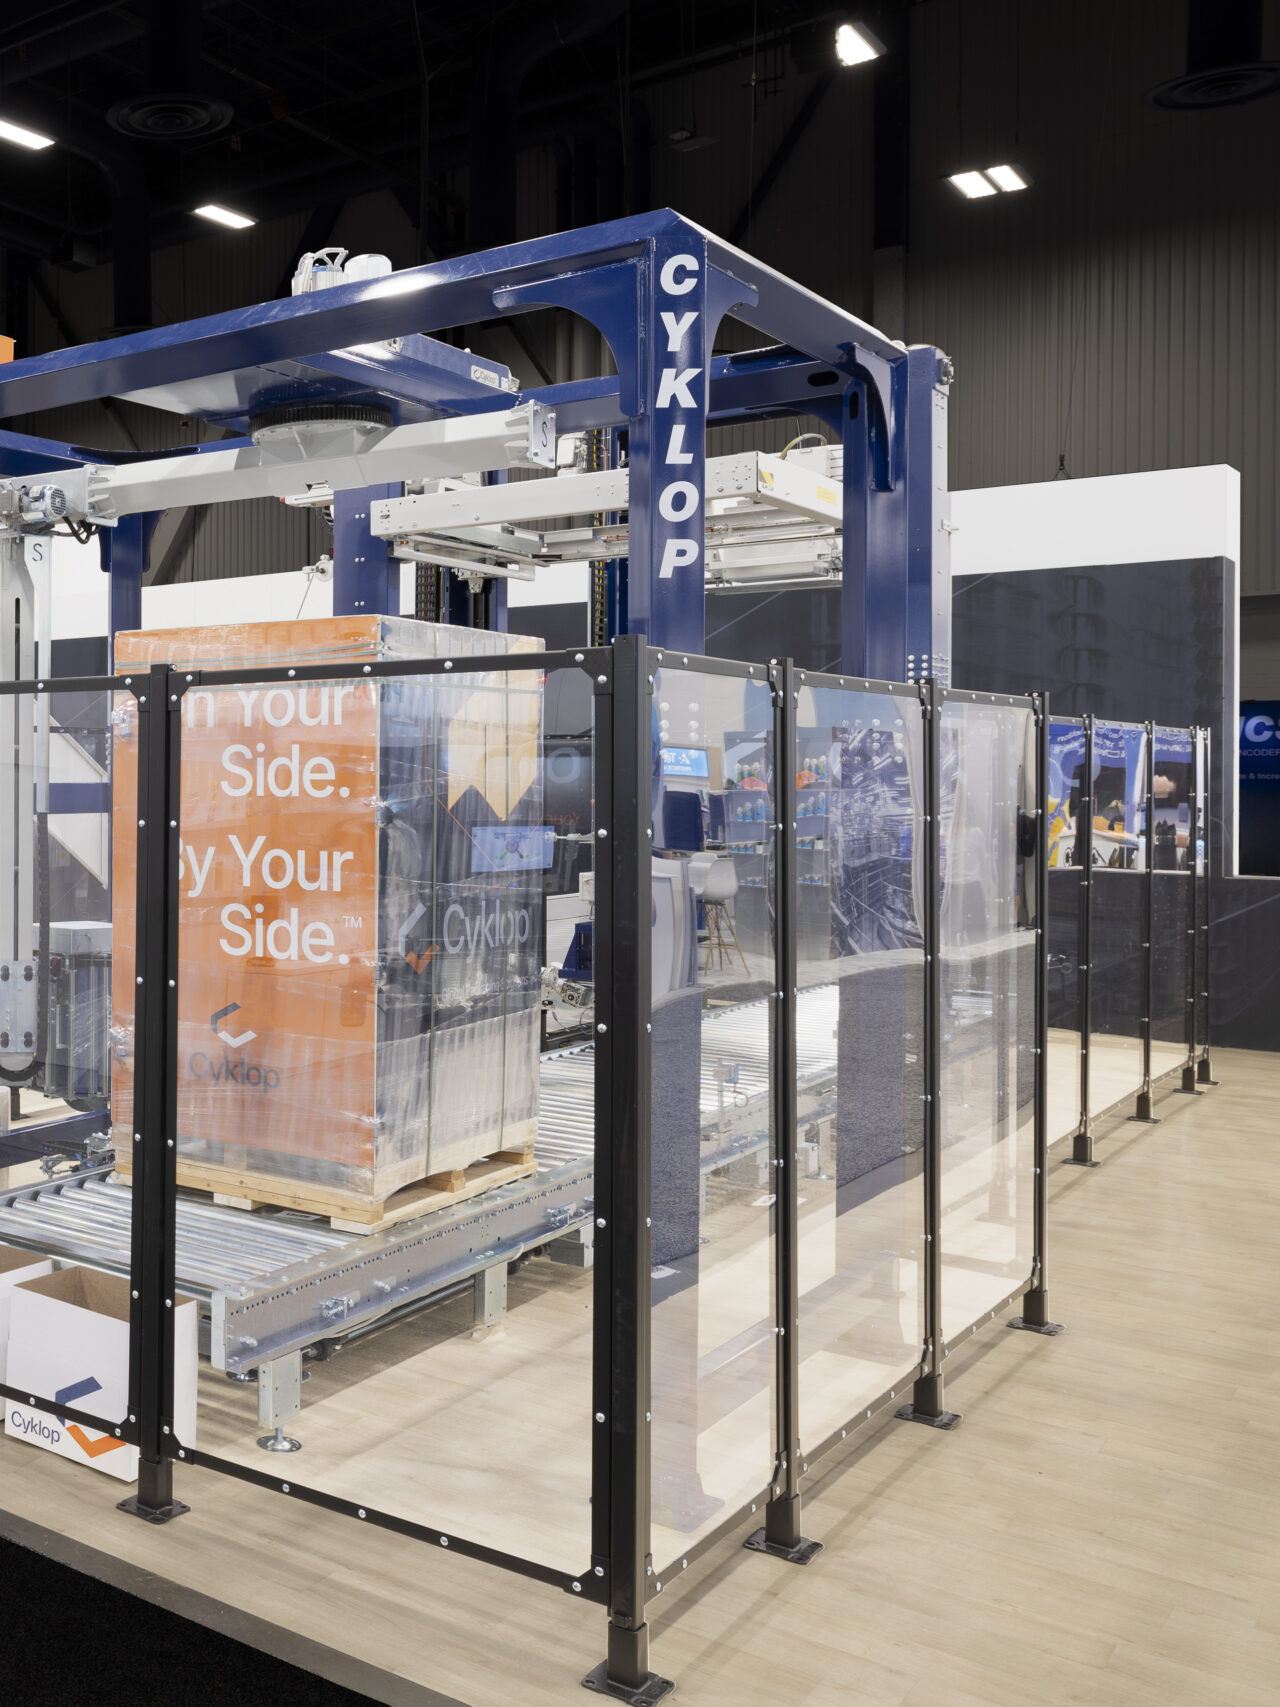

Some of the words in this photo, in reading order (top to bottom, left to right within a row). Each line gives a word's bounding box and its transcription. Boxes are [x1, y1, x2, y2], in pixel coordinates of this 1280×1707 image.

[655, 253, 704, 579] CYKLOP
[31, 543, 44, 562] S
[236, 684, 355, 728] Your
[220, 742, 351, 799] Side.
[227, 834, 355, 893] Your
[442, 898, 530, 964] Cyklop
[189, 1051, 281, 1095] Cyklop
[11, 1410, 62, 1445] Cyklop
